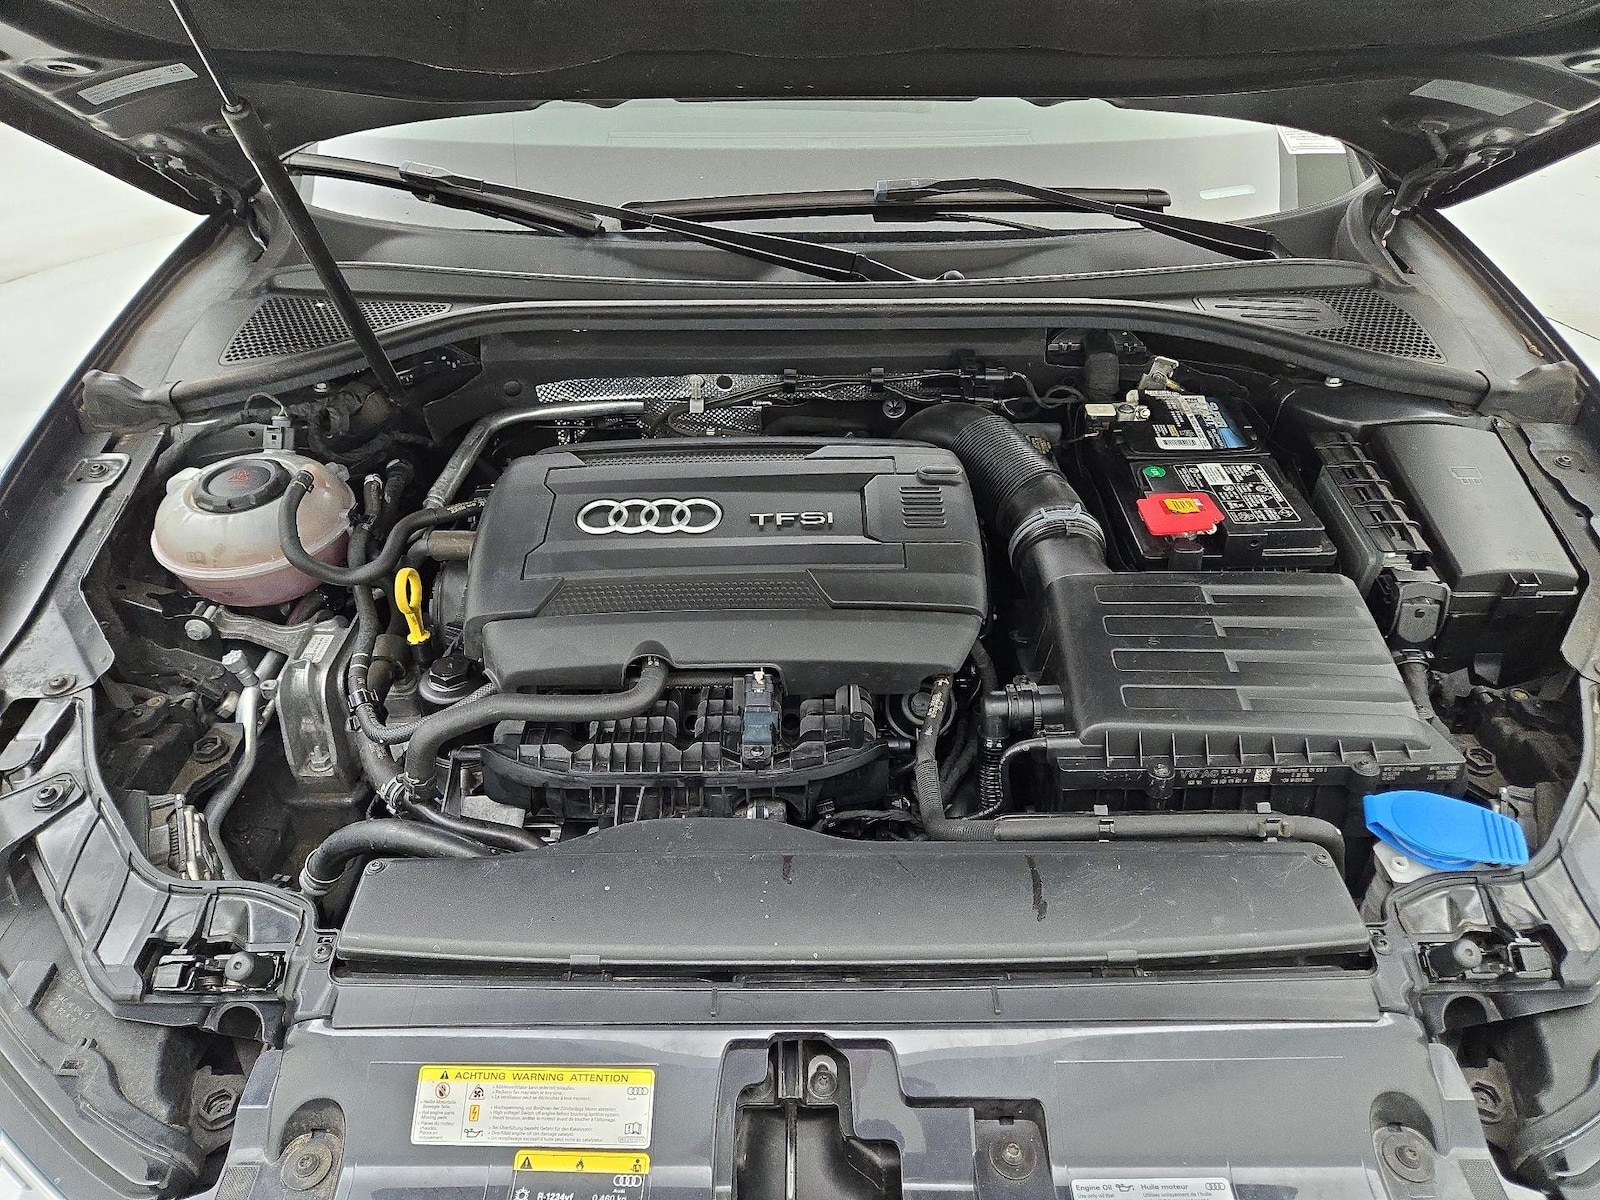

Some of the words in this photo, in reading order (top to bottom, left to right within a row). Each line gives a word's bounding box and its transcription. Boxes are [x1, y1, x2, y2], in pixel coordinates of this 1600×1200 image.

[749, 511, 834, 529] TFSI
[1201, 769, 1220, 779] AG
[454, 1071, 506, 1080] ACHTUNG
[512, 1072, 564, 1082] WARNING
[570, 1073, 629, 1083] ATTENTION
[1075, 1184, 1101, 1192] Engine
